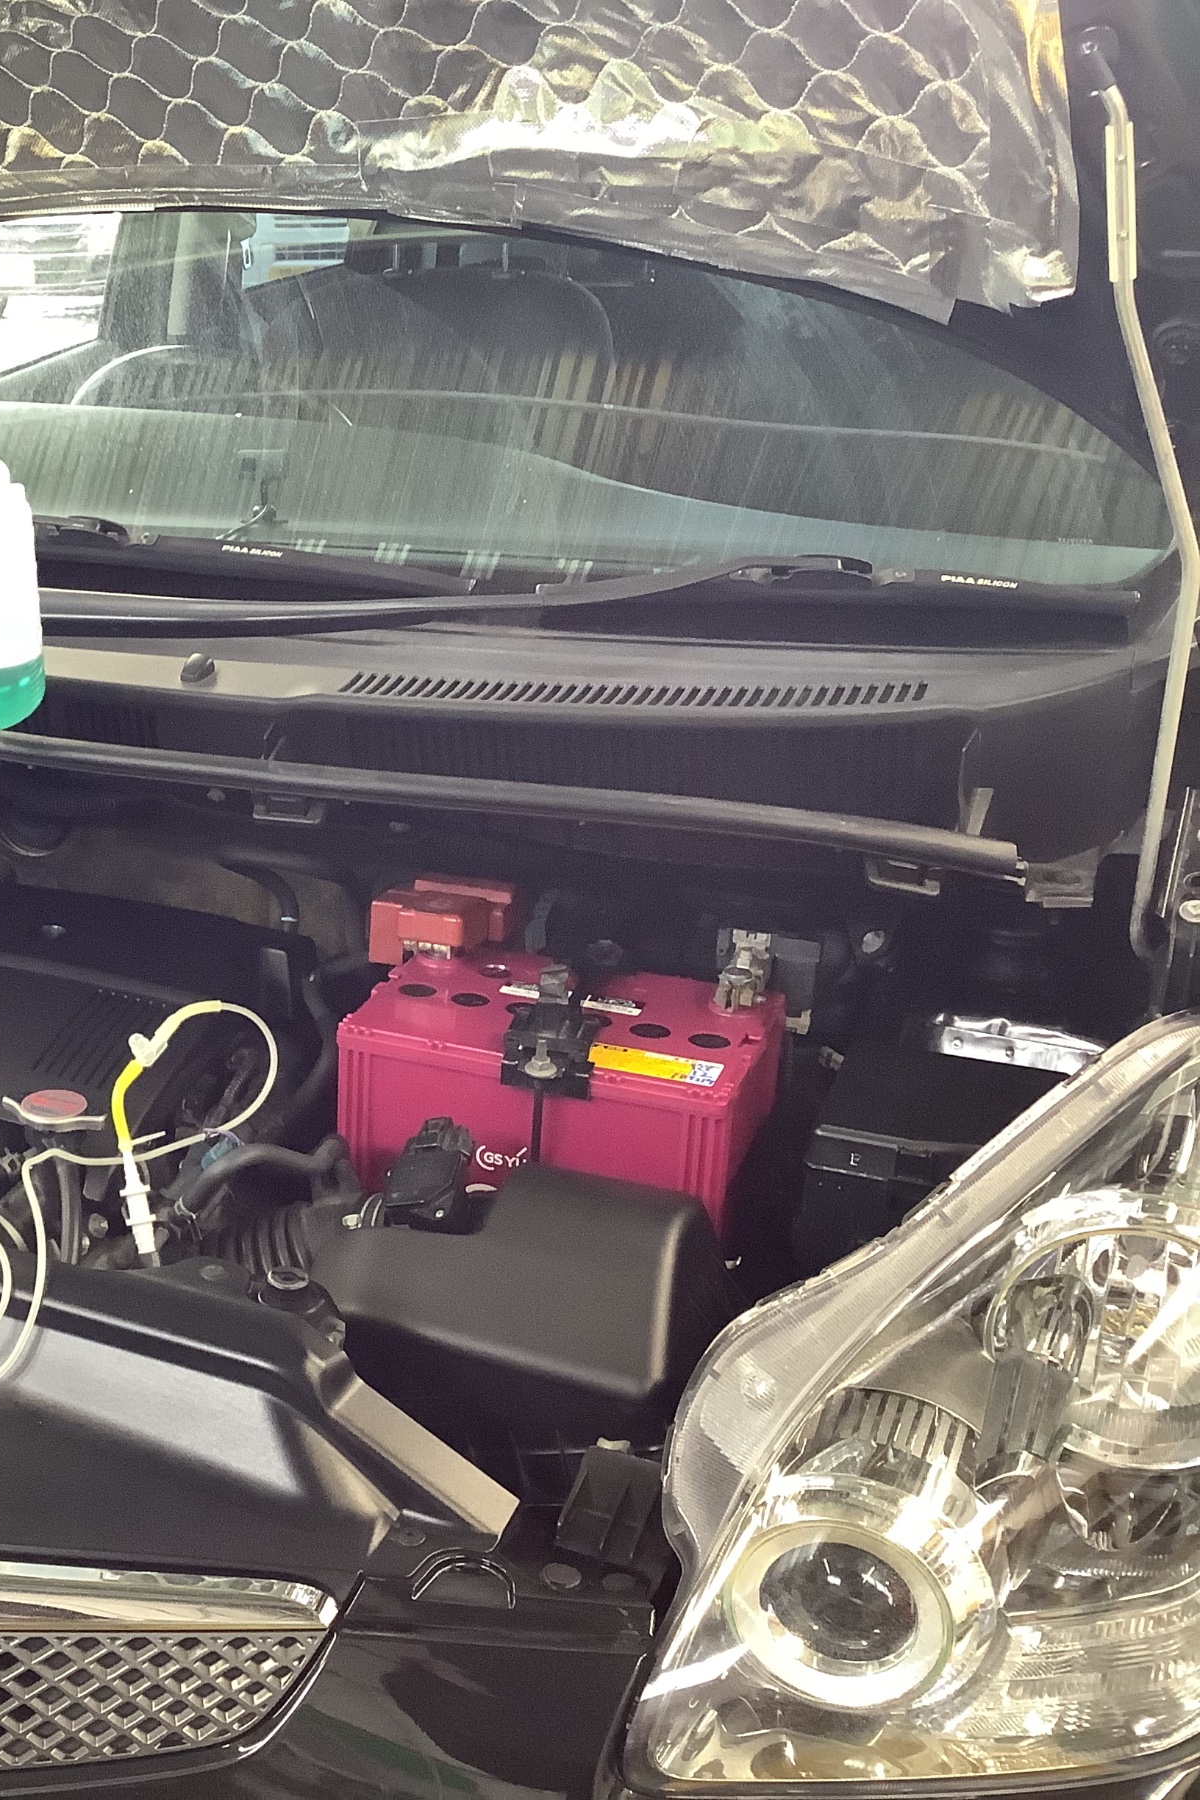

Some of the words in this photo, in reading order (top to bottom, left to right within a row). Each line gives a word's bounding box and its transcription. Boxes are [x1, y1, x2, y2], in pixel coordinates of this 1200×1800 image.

[221, 544, 249, 554] PIAA
[941, 574, 975, 584] PIAA
[977, 578, 1018, 589] SILICON
[483, 1151, 503, 1166] GS
